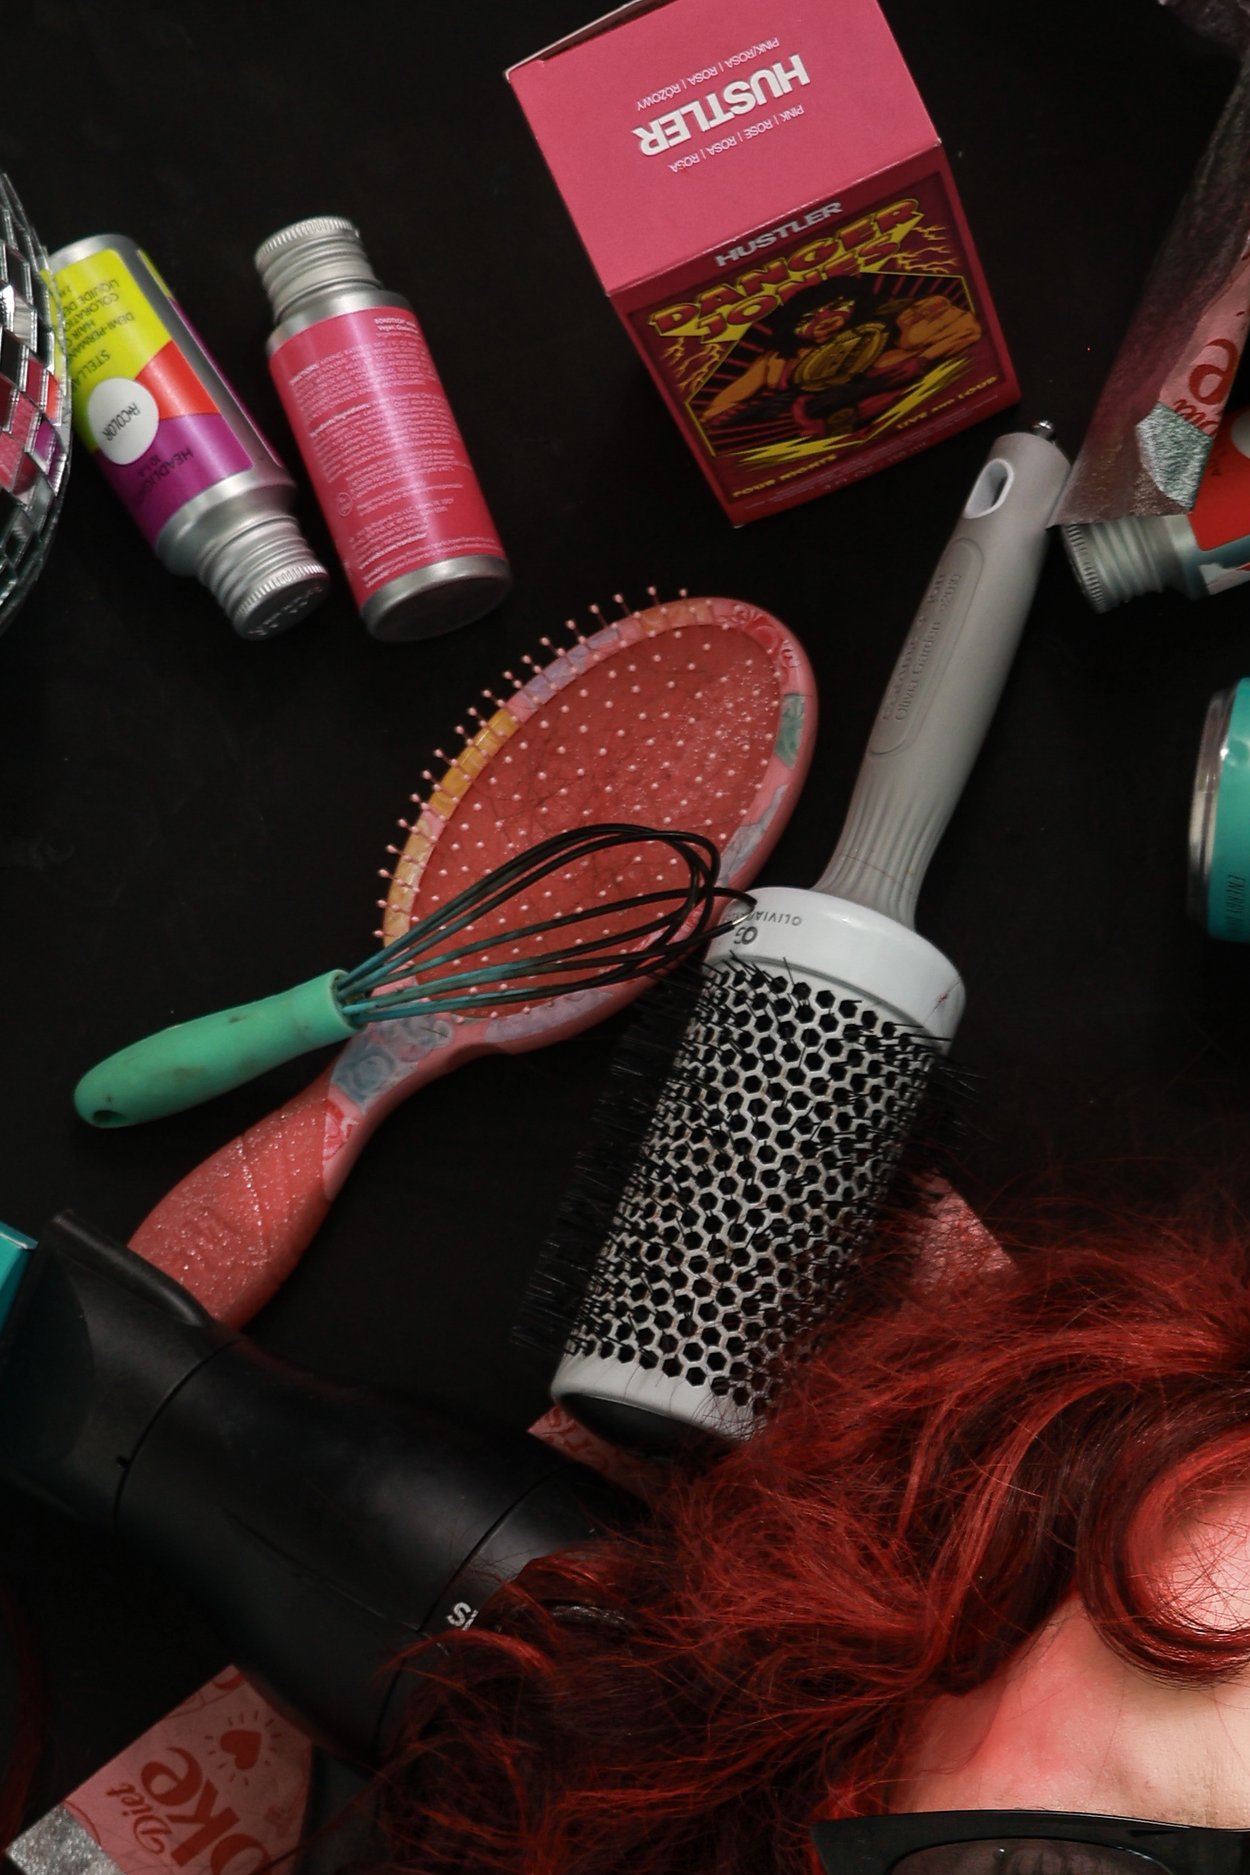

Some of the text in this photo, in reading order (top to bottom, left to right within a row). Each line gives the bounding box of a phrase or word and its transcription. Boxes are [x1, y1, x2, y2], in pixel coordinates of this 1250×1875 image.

[723, 36, 780, 68] PINK/ROSA
[687, 65, 718, 86] ROSA
[630, 53, 810, 156] HUSTLER
[667, 103, 804, 173] PINK ROSE ROSA ROSA
[713, 199, 844, 268] HUSTLER
[646, 196, 925, 335] DANGER
[77, 277, 119, 305] LIQUIDE
[694, 232, 903, 343] JONES
[63, 289, 120, 331] COLORATIO
[70, 319, 96, 340] HAIR
[65, 310, 135, 362] DEMI-PERMAN
[71, 349, 110, 386] STELLA
[1226, 874, 1244, 914] ENERGY
[754, 911, 801, 926] OLIVIA
[105, 1783, 172, 1856] Diet
